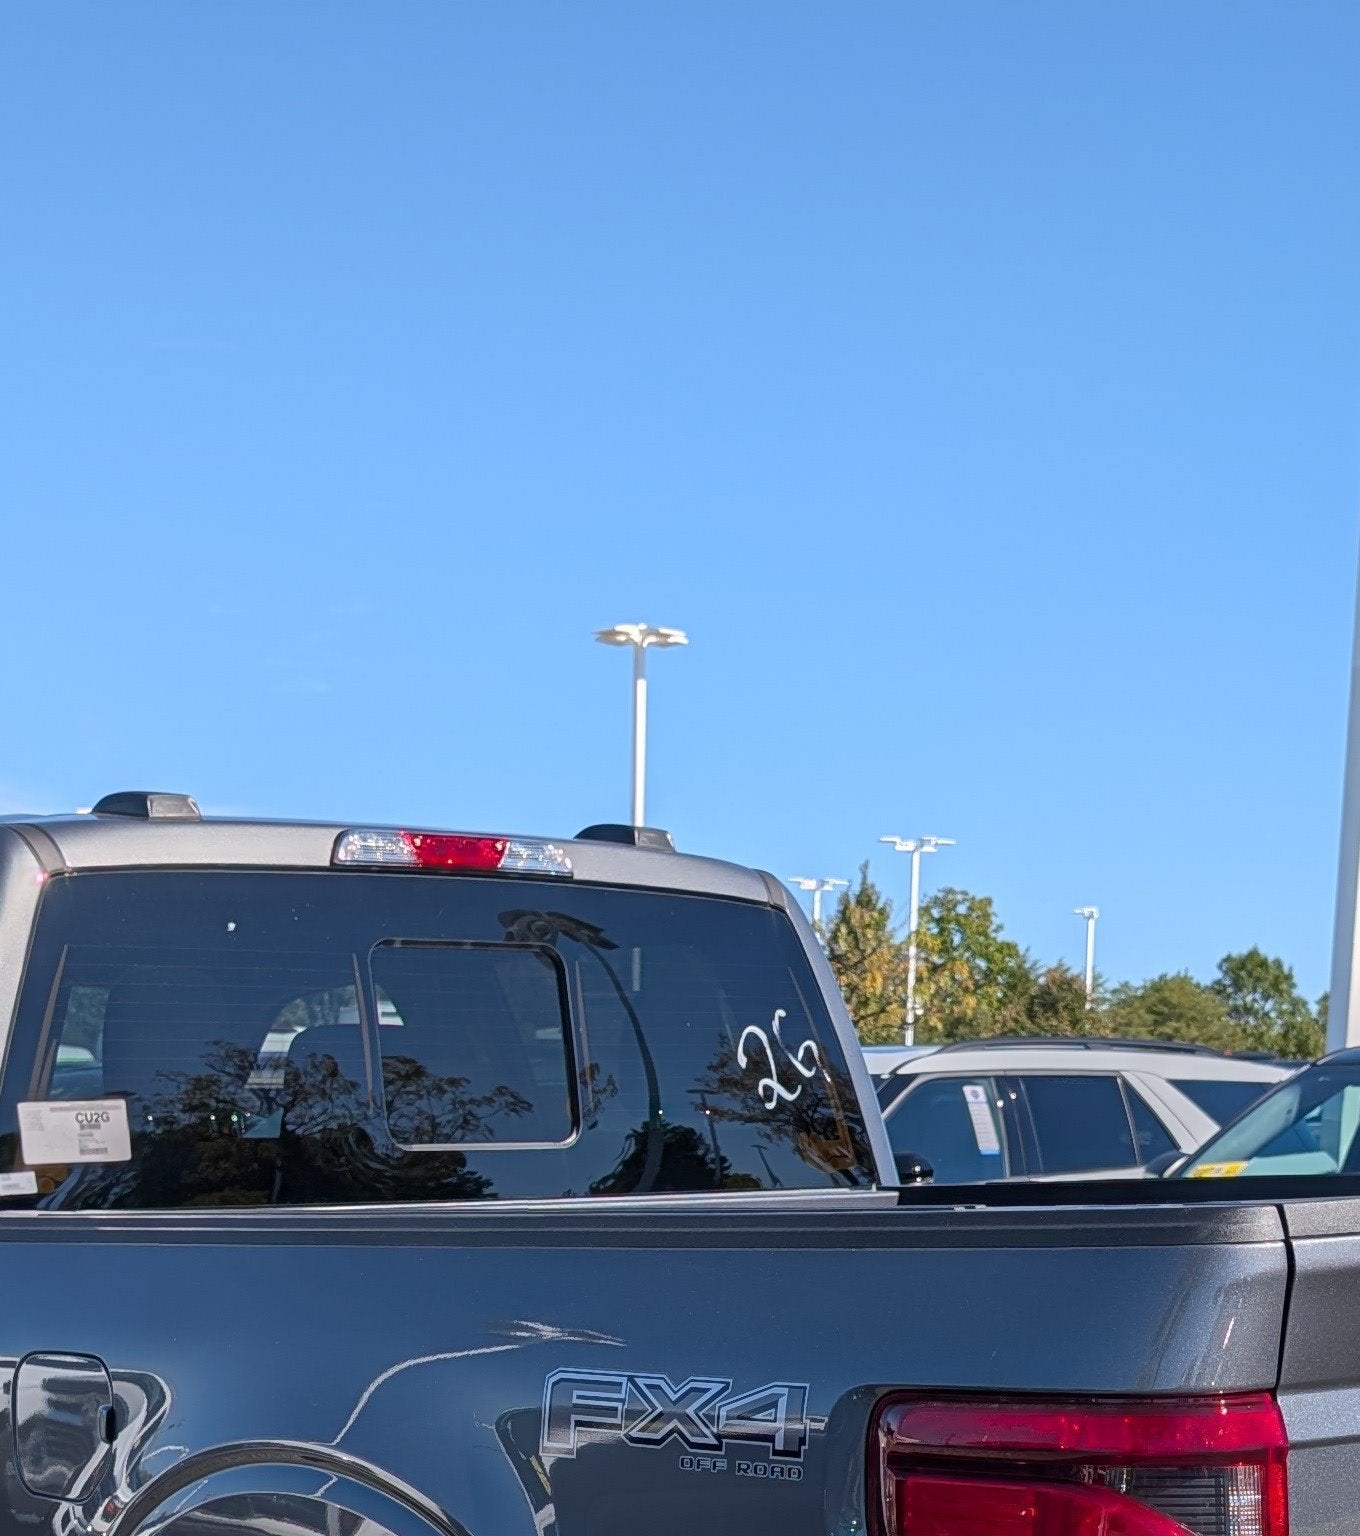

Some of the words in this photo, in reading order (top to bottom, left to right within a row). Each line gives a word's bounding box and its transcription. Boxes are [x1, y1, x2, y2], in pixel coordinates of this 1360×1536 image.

[737, 1008, 832, 1110] 26
[75, 1111, 110, 1124] CU2G
[540, 1367, 809, 1462] FX4
[678, 1455, 728, 1474] OFF
[735, 1460, 804, 1482] ROAD
